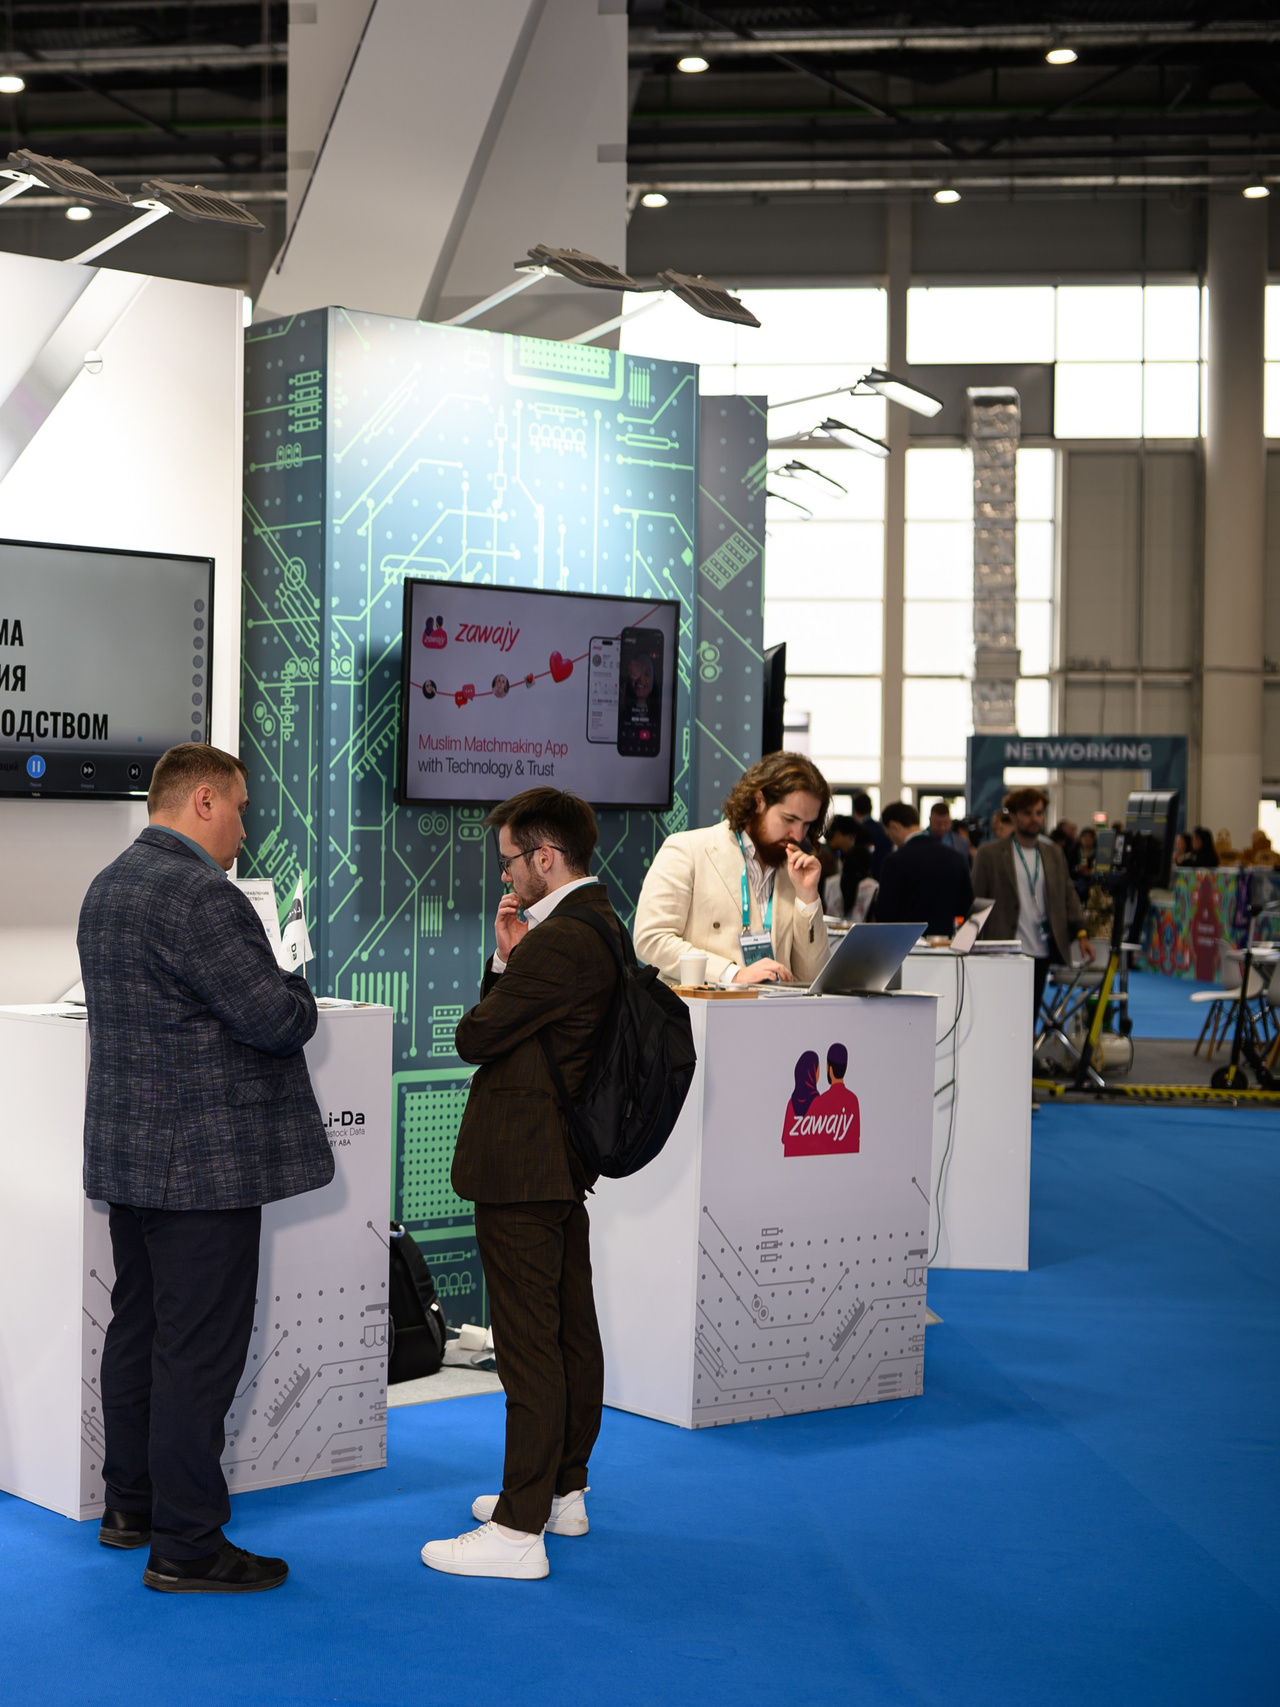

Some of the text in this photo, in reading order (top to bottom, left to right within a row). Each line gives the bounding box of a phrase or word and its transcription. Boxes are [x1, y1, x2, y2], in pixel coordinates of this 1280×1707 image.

[455, 620, 520, 652] zawajy
[418, 734, 569, 758] Muslim Matchmaking App
[1004, 741, 1153, 762] NETWORKING
[418, 757, 555, 778] with Technology & Trust
[350, 1127, 365, 1136] Data
[789, 1107, 854, 1141] zawajy
